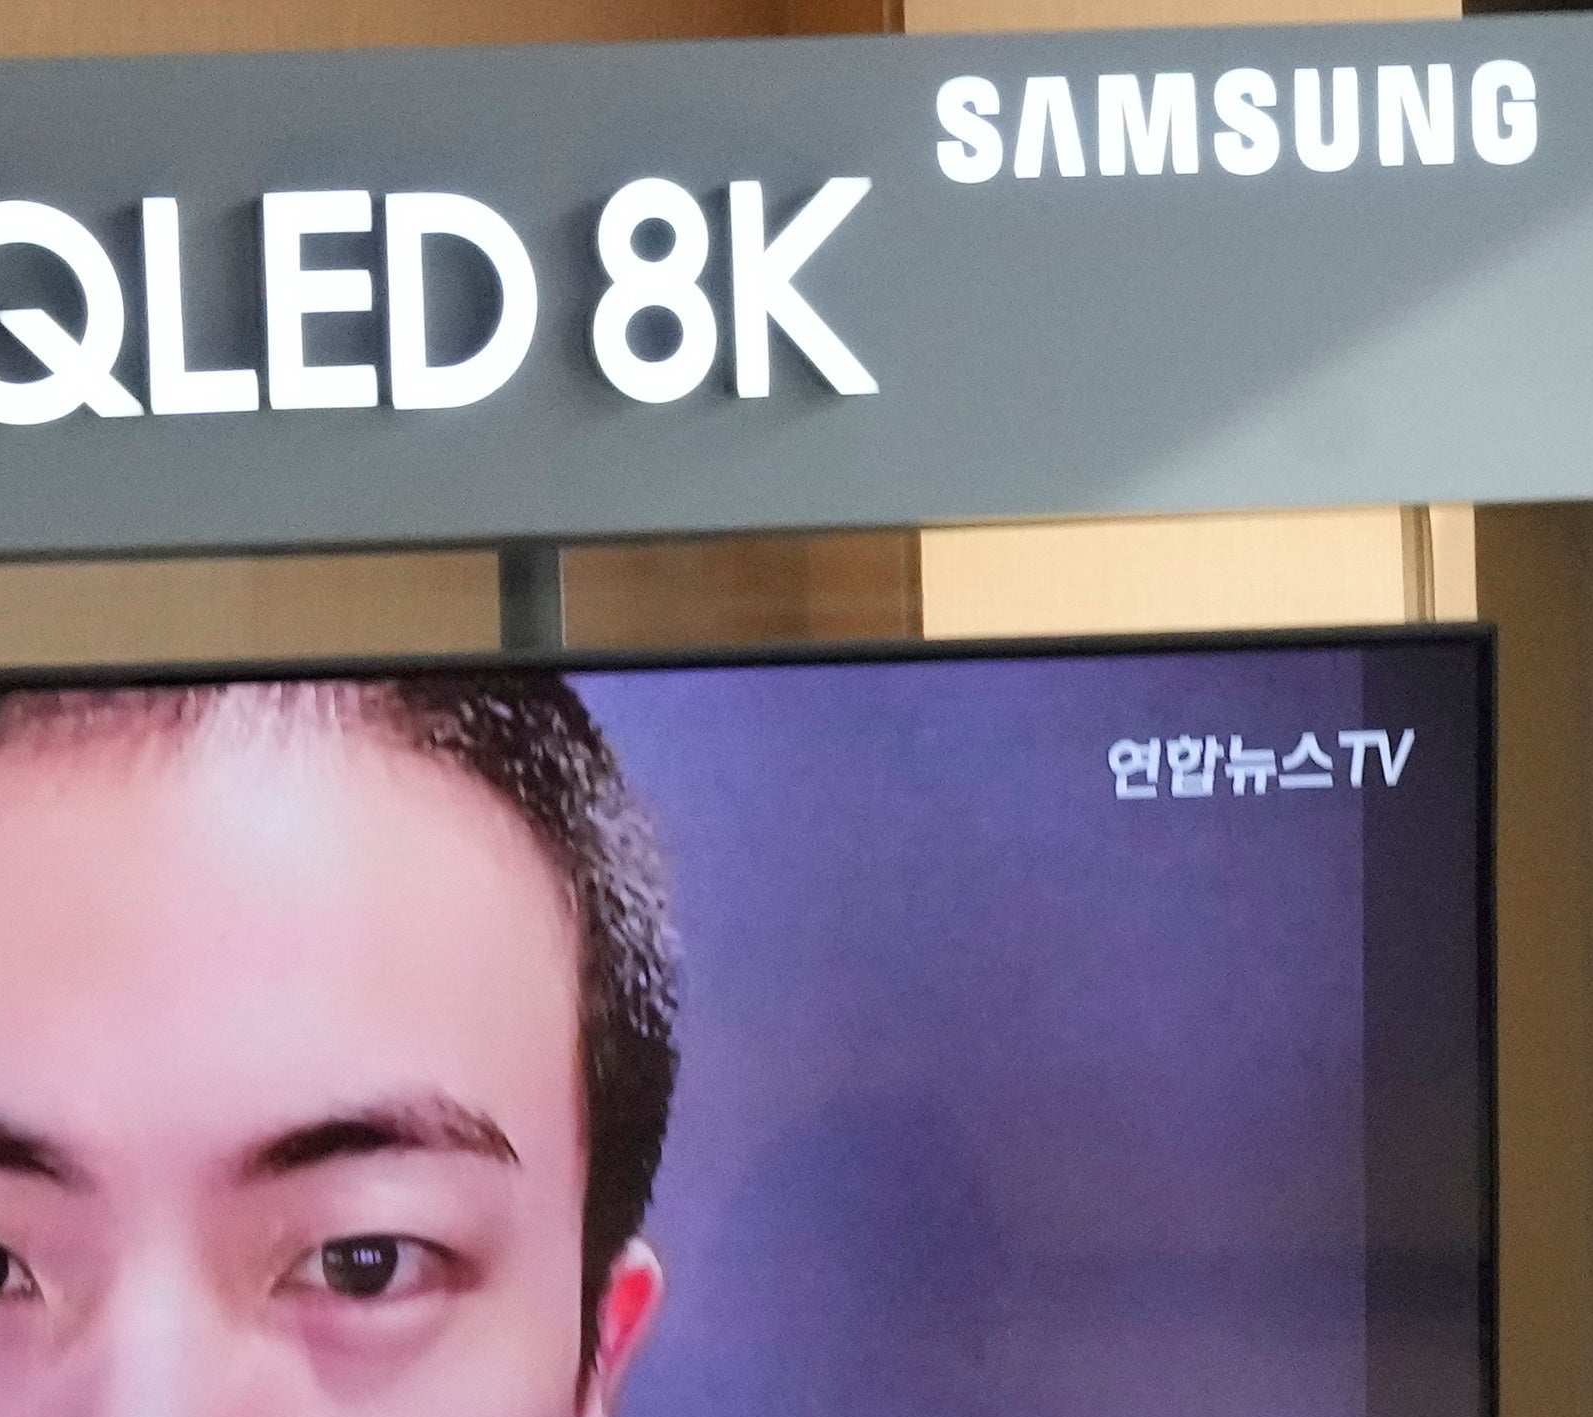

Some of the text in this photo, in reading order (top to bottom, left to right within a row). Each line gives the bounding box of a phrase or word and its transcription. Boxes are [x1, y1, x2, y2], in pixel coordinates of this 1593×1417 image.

[935, 59, 1538, 185] SAMSUNG
[592, 176, 879, 404] 8K
[1108, 728, 1416, 800] 연합뉴스TV
